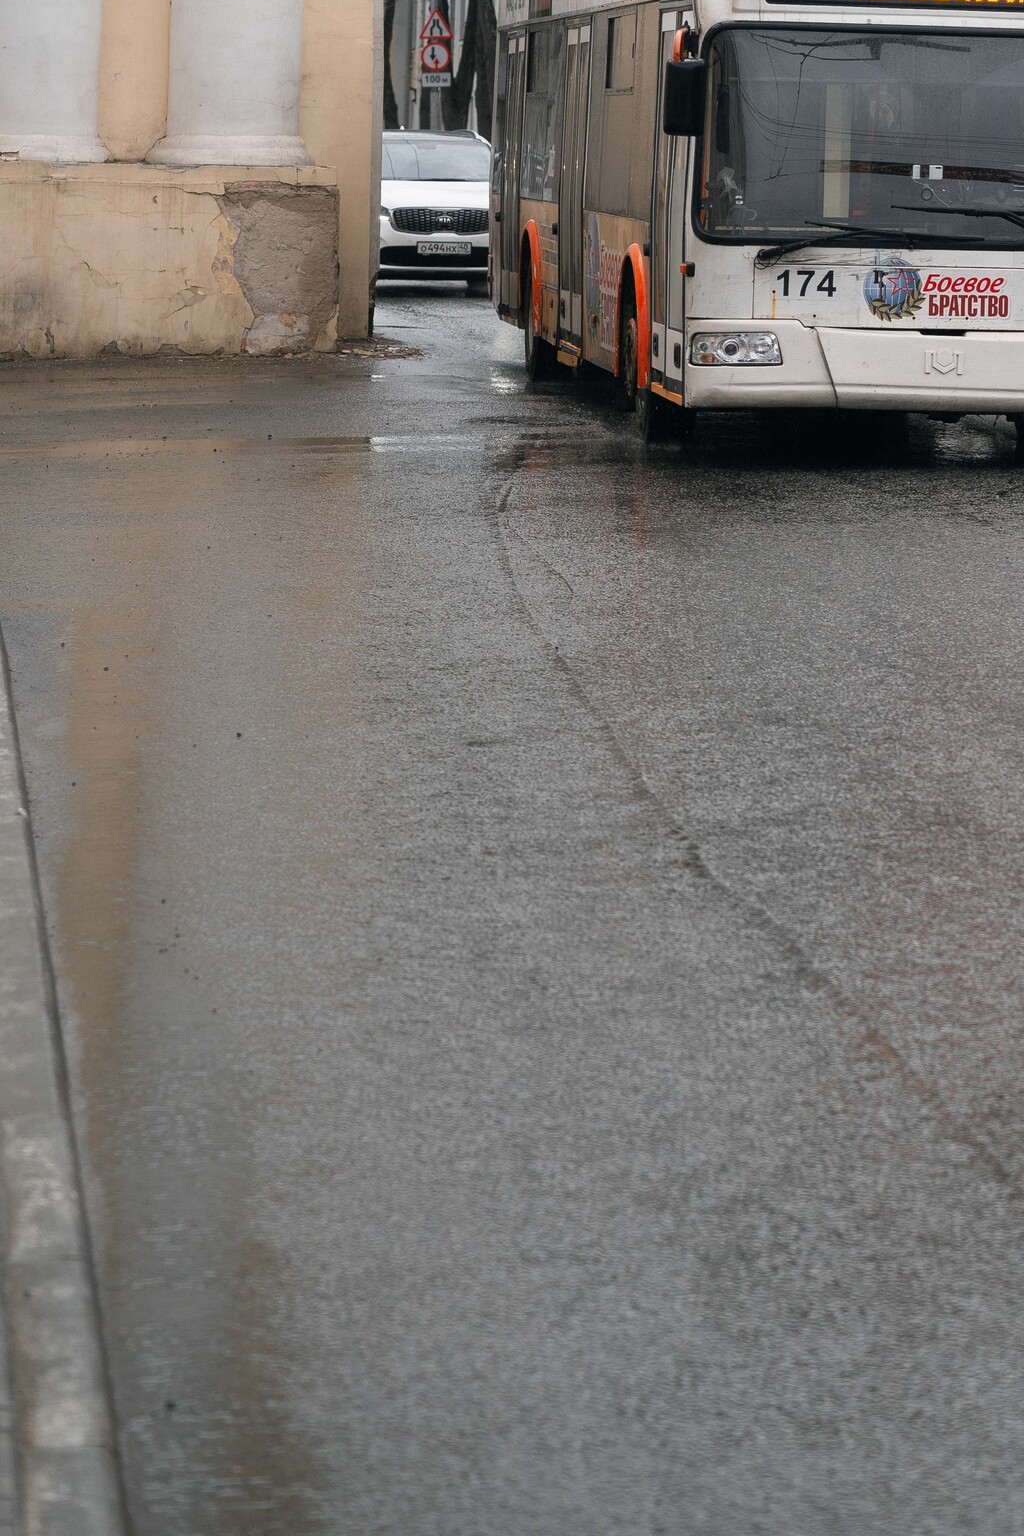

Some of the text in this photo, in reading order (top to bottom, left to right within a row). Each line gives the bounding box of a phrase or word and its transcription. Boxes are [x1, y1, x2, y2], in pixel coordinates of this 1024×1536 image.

[425, 75, 440, 83] 100
[459, 243, 469, 251] 40
[776, 269, 837, 298] 174
[922, 273, 1005, 294] Боевое
[928, 294, 1009, 318] БРАТСТВО
